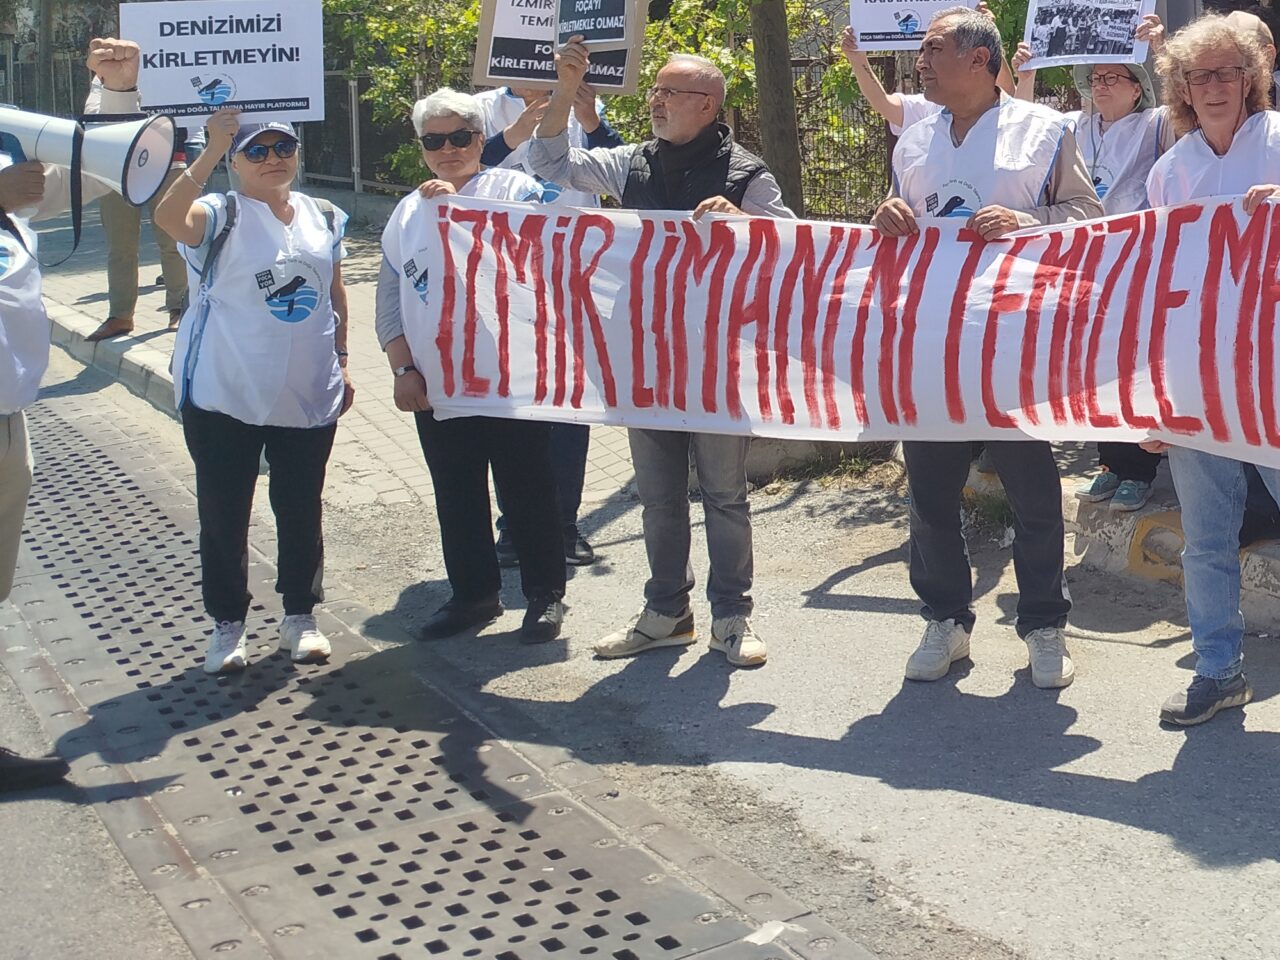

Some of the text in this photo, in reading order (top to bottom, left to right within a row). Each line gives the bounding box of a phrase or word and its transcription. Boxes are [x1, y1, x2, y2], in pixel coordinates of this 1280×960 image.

[159, 13, 282, 37] DENİZİMİZİ
[596, 16, 624, 29] OLMAZ
[143, 43, 300, 69] KİRLETMEYİN!
[490, 55, 556, 71] KİRLETME
[187, 104, 208, 113] DOĞA
[266, 101, 307, 109] PLATFORMU
[436, 204, 618, 410] İZMİR
